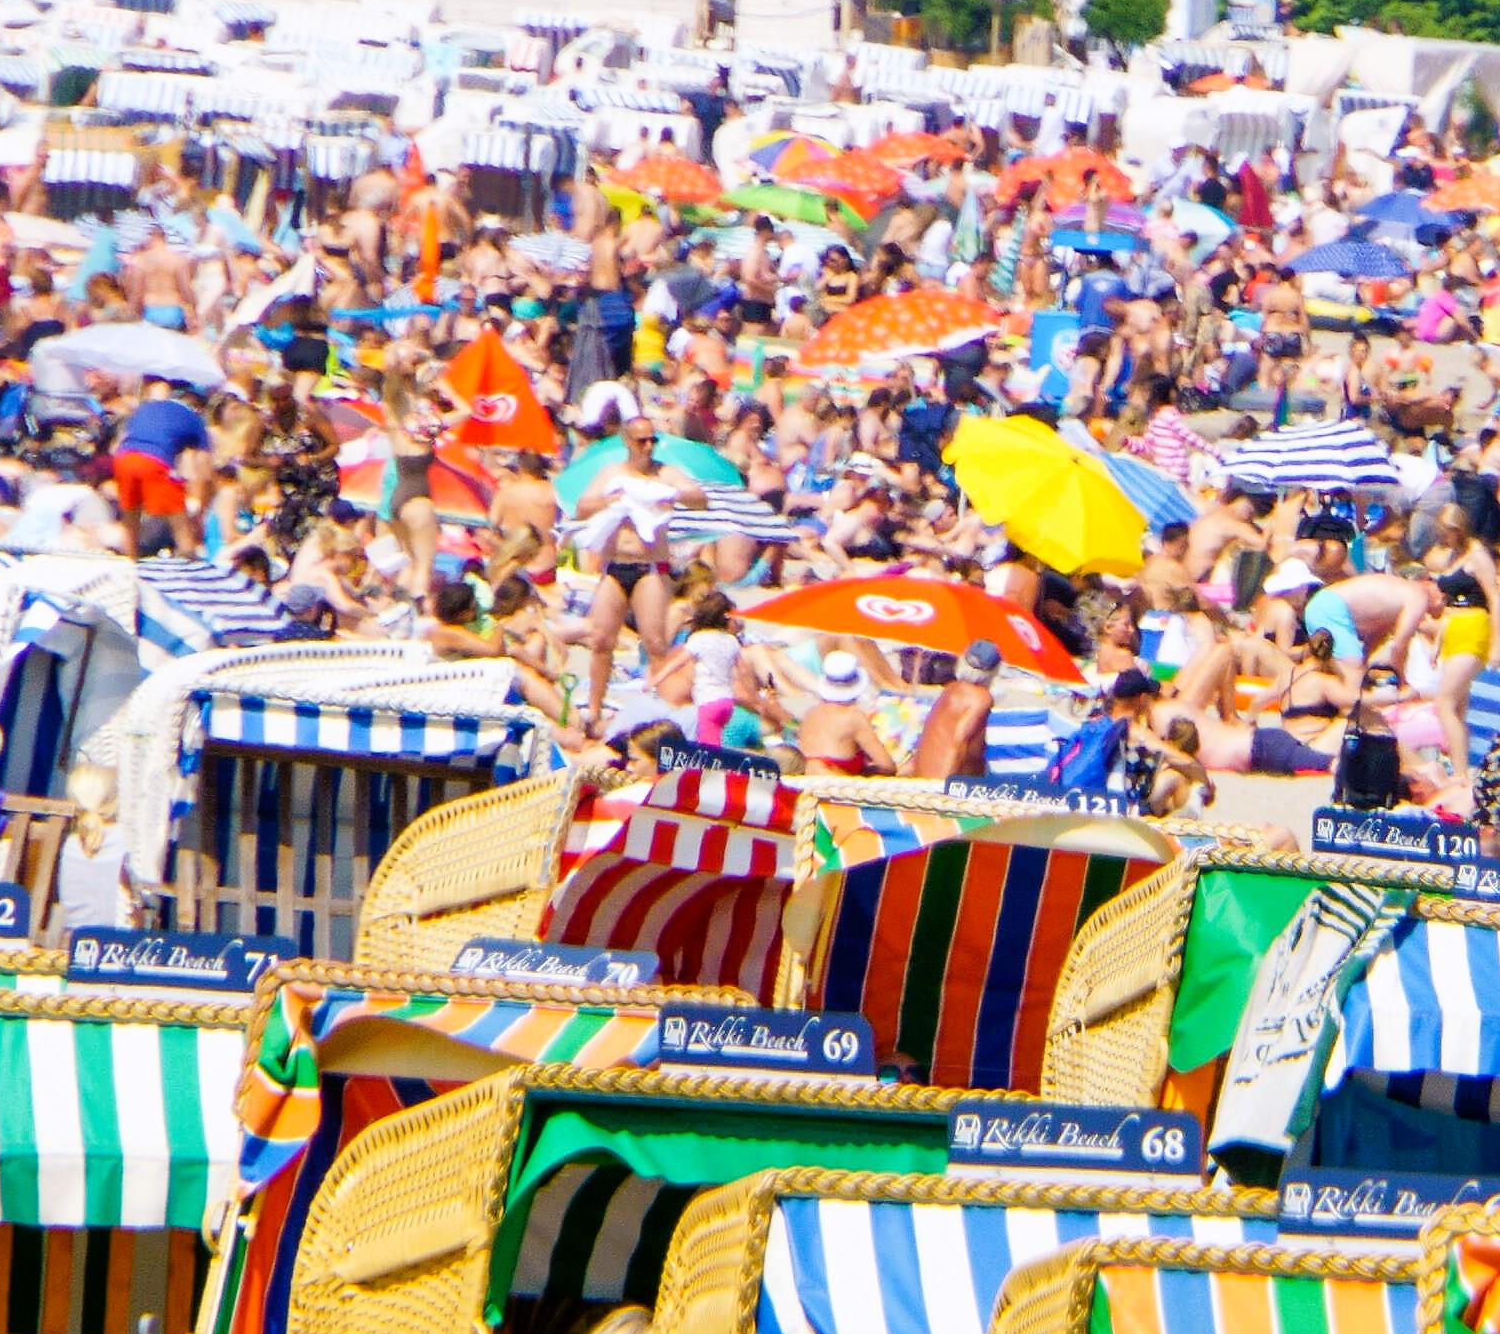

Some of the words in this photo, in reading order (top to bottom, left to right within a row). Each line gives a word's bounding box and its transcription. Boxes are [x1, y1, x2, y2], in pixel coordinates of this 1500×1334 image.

[1079, 796, 1119, 816] 121
[1385, 822, 1441, 848] Beach
[1436, 833, 1477, 856] 120
[99, 938, 165, 971] Rikki
[167, 939, 244, 971] Beach
[481, 948, 543, 973] Rikki
[537, 953, 612, 976] Beach
[601, 962, 639, 985] 70
[687, 1016, 748, 1052] Rikki
[750, 1016, 820, 1051] Beach
[823, 1028, 858, 1062] 69
[981, 1113, 1053, 1149] Rikki
[1057, 1113, 1141, 1149] Beach
[1141, 1126, 1186, 1164] 68
[1314, 1179, 1388, 1219] Rikki
